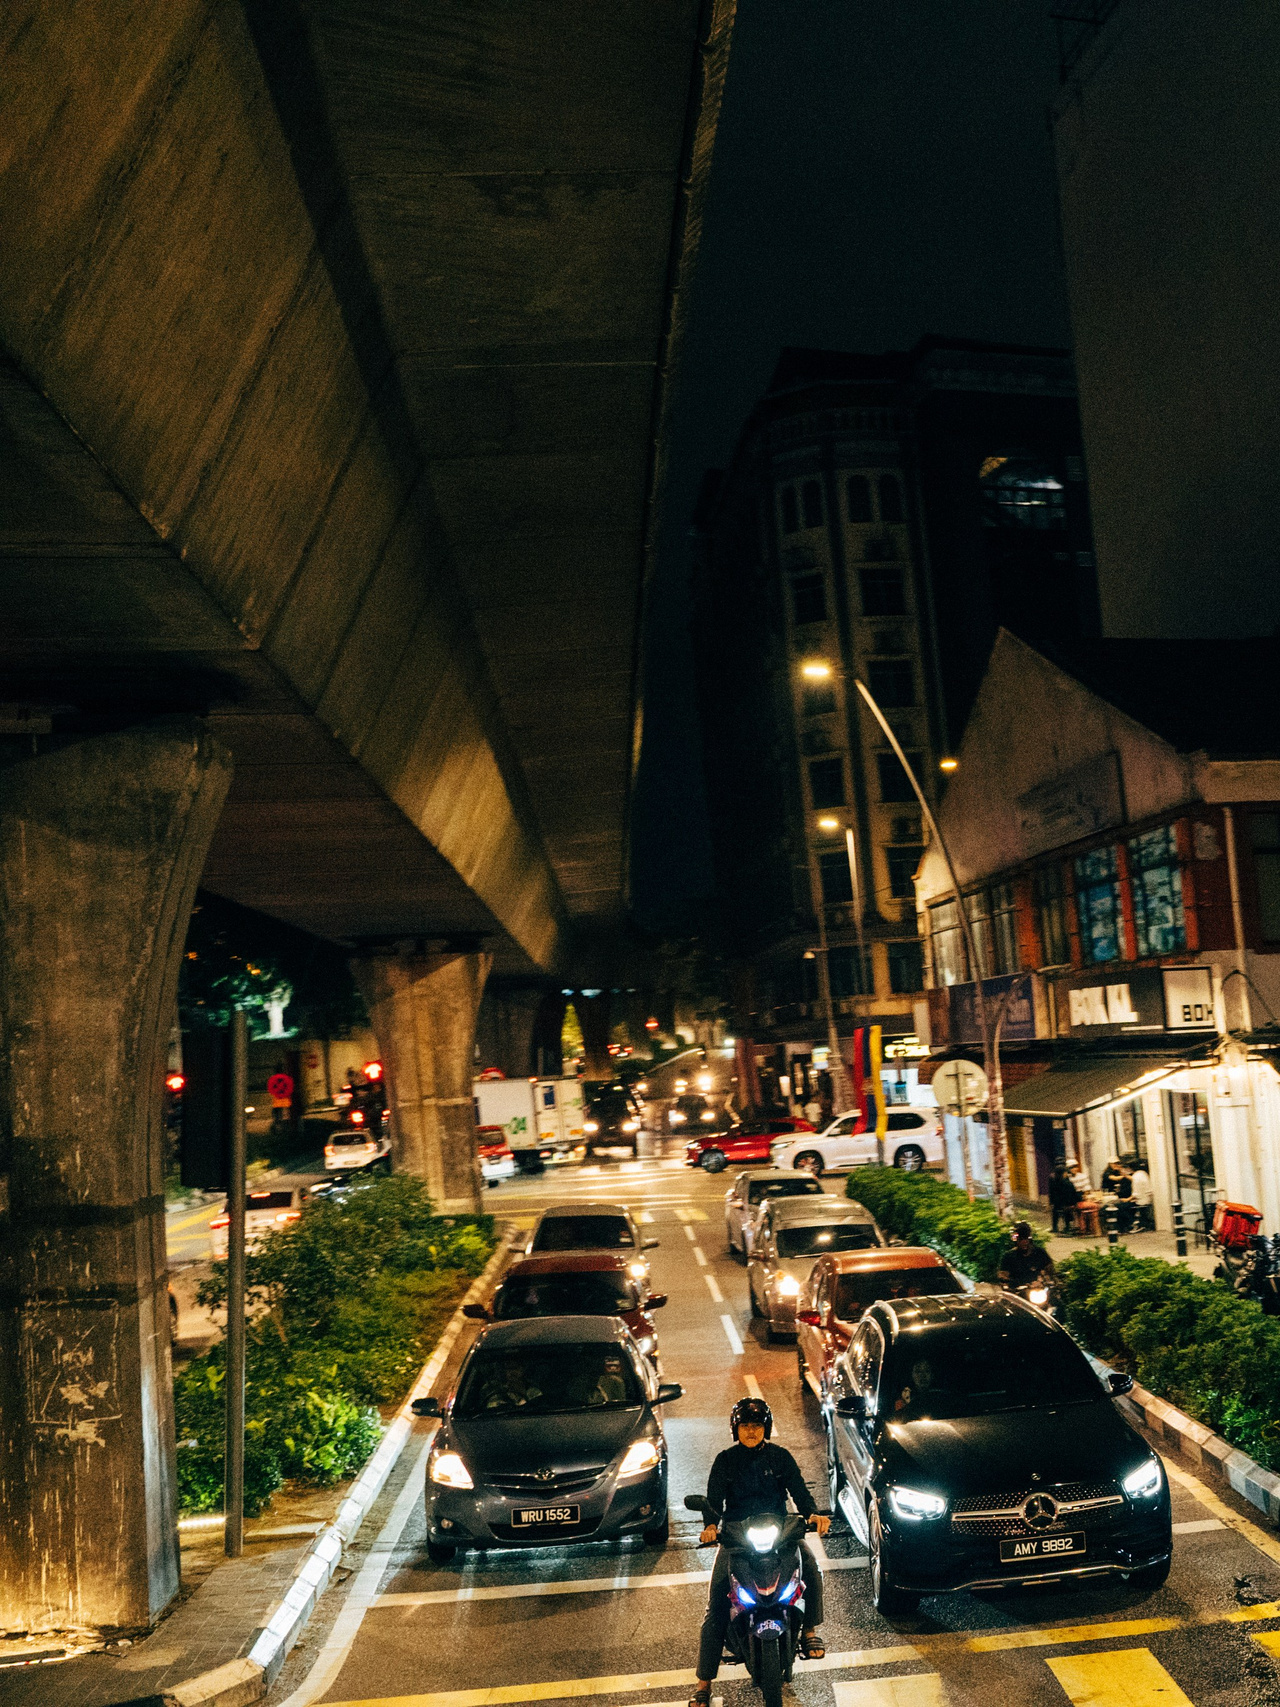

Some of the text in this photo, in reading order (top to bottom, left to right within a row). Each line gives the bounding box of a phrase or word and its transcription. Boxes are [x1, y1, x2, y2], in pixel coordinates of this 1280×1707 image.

[521, 1508, 571, 1522] WRU 1552
[1014, 1538, 1073, 1556] AMY 9892
